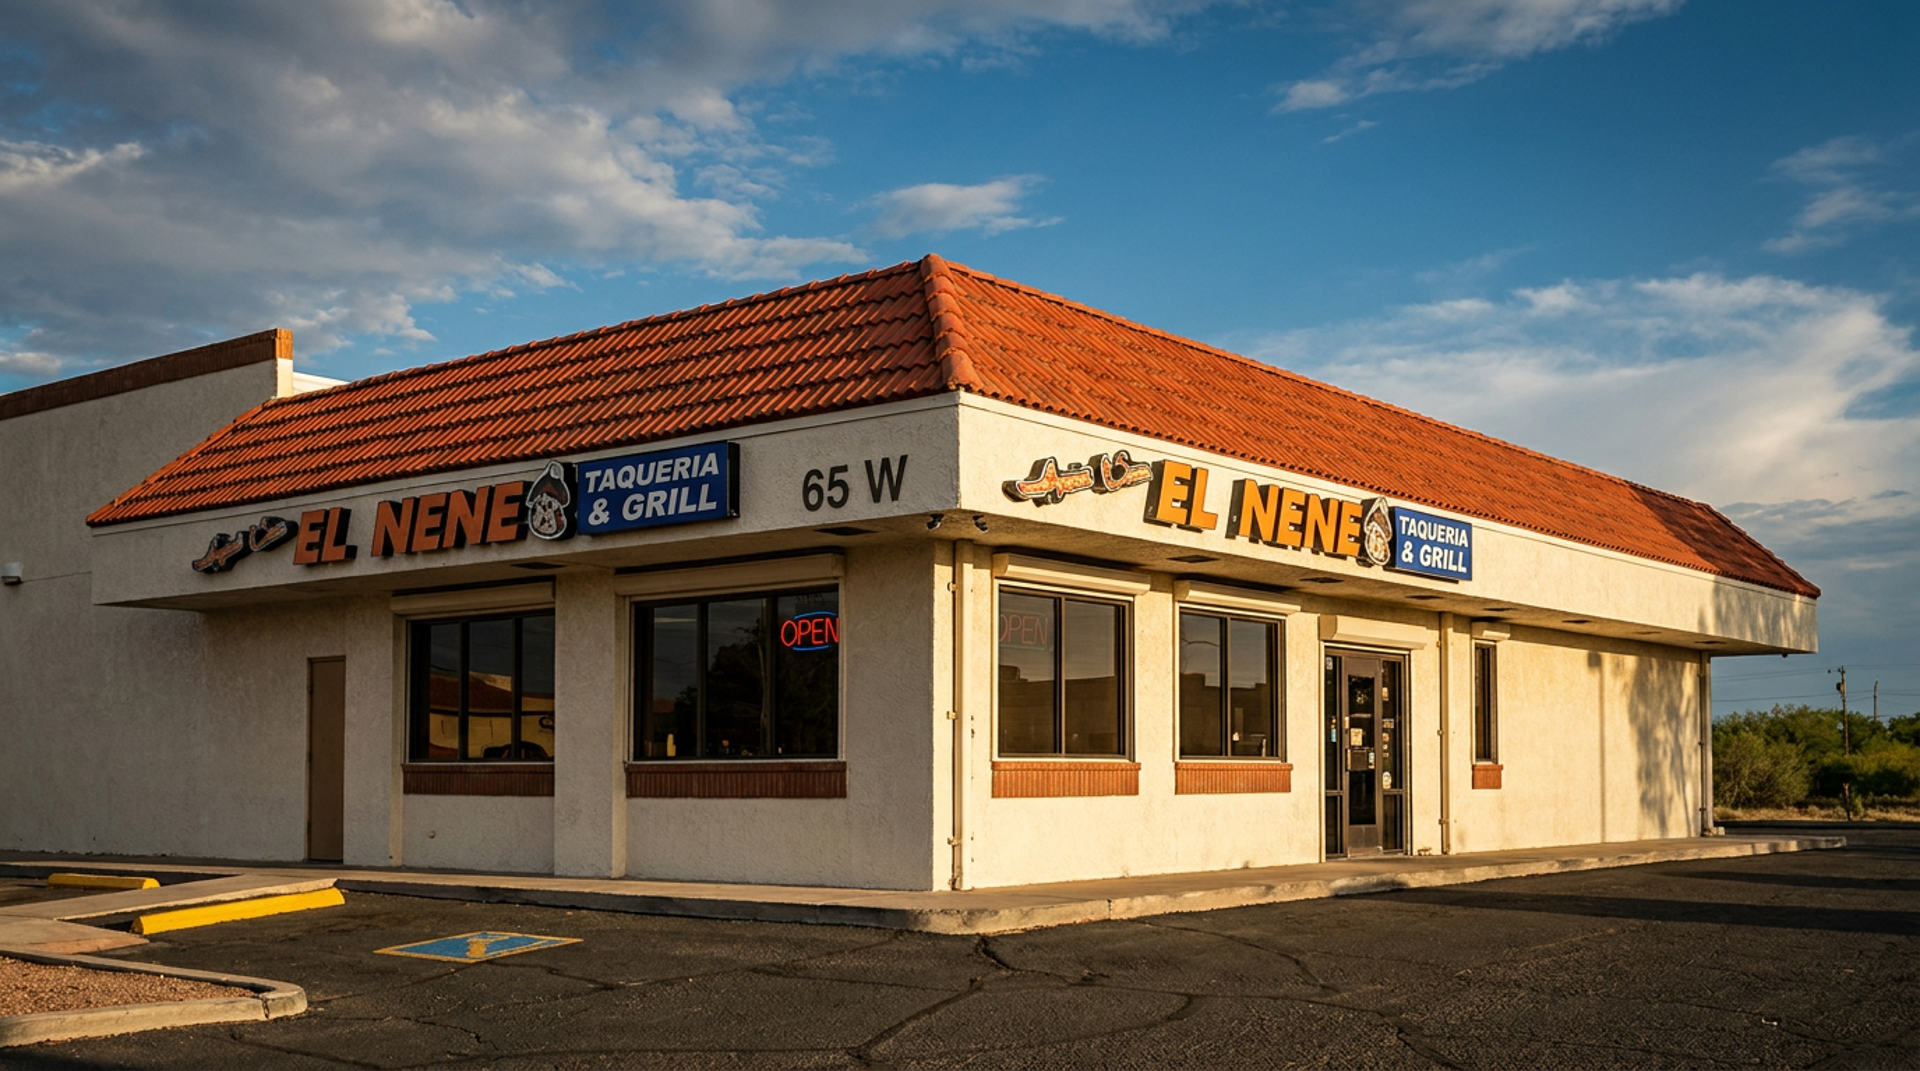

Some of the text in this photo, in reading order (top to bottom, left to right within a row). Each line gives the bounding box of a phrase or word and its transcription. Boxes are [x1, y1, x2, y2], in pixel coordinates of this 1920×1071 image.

[585, 452, 720, 493] TAQUERIA
[802, 454, 909, 511] 65 W
[293, 480, 524, 565] EL NENE
[588, 484, 718, 526] & GRILL
[1156, 459, 1364, 557] EL NENE
[1399, 515, 1469, 548] TAQUERIA
[1401, 543, 1467, 573] & GRILL
[780, 617, 840, 647] OPEN
